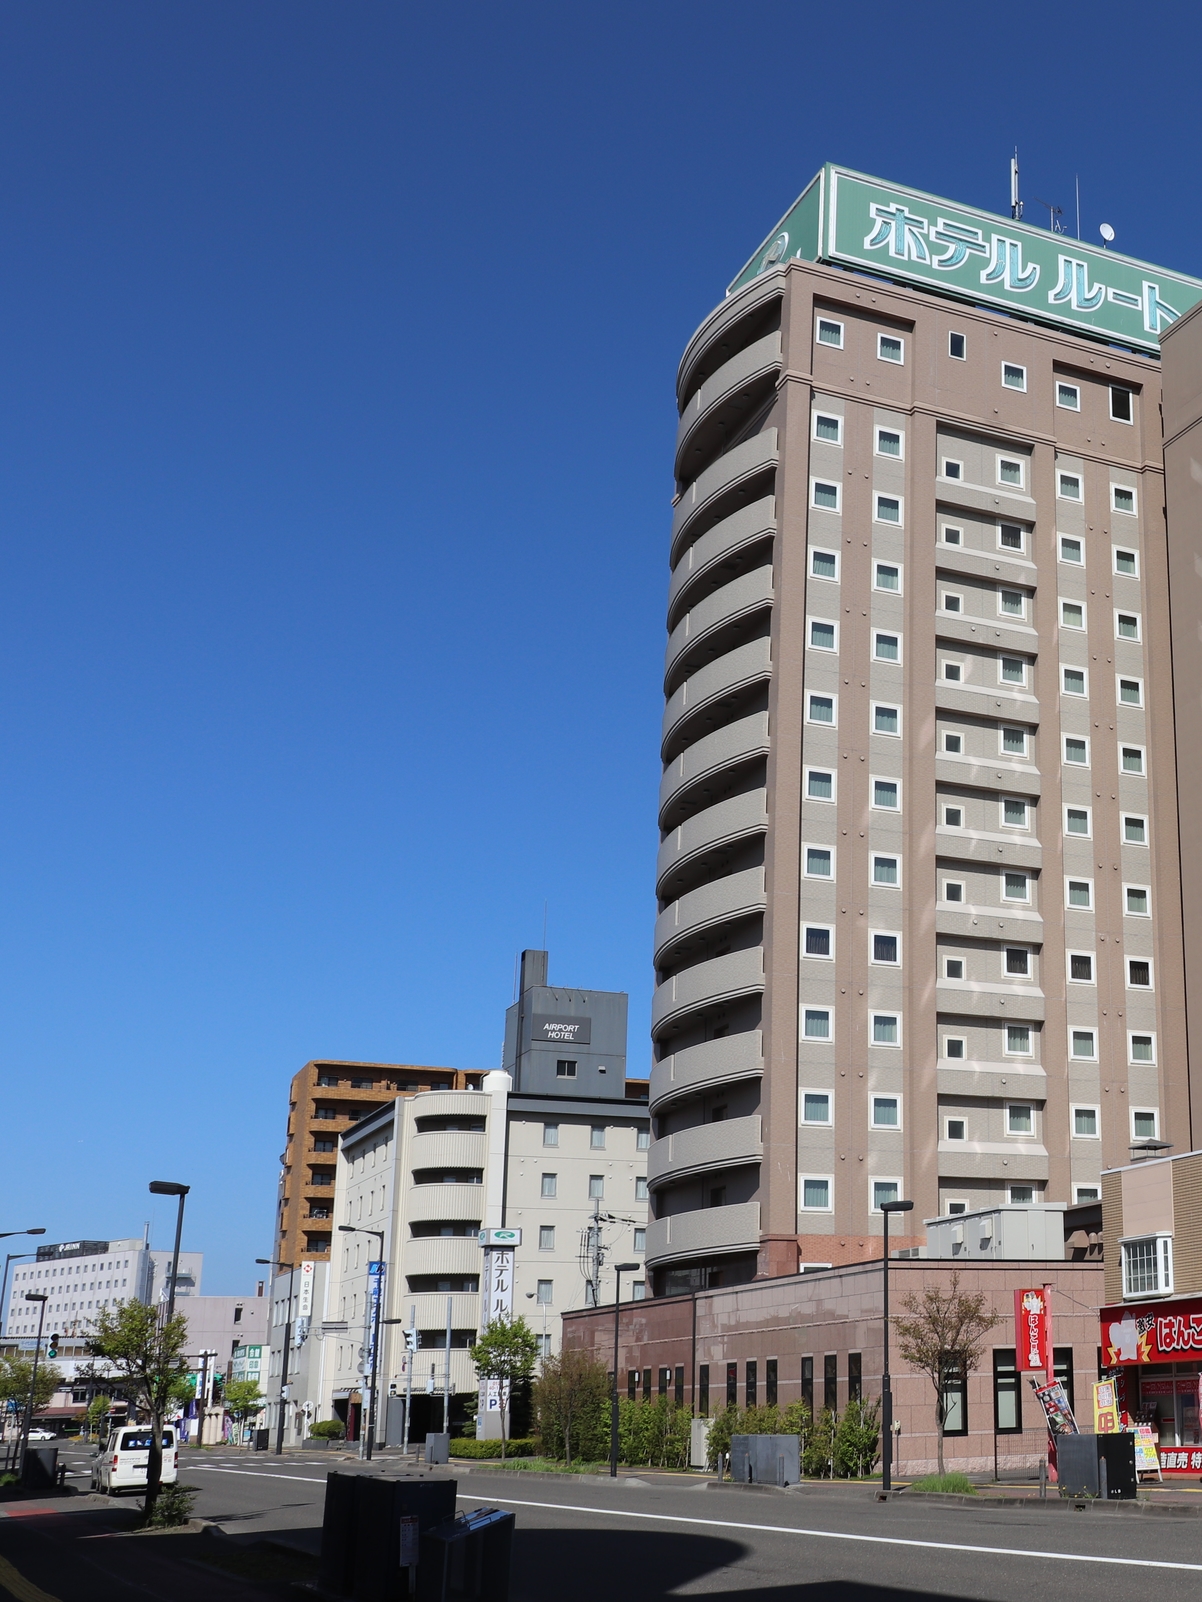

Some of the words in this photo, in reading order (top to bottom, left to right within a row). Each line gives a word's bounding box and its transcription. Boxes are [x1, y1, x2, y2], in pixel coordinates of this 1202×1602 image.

[864, 202, 1040, 292] ホテル
[1048, 253, 1182, 334] ルート
[543, 1022, 579, 1033] AIRPORT
[548, 1031, 574, 1040] HOTEL
[494, 1250, 510, 1293] ホテル
[490, 1399, 498, 1410] P
